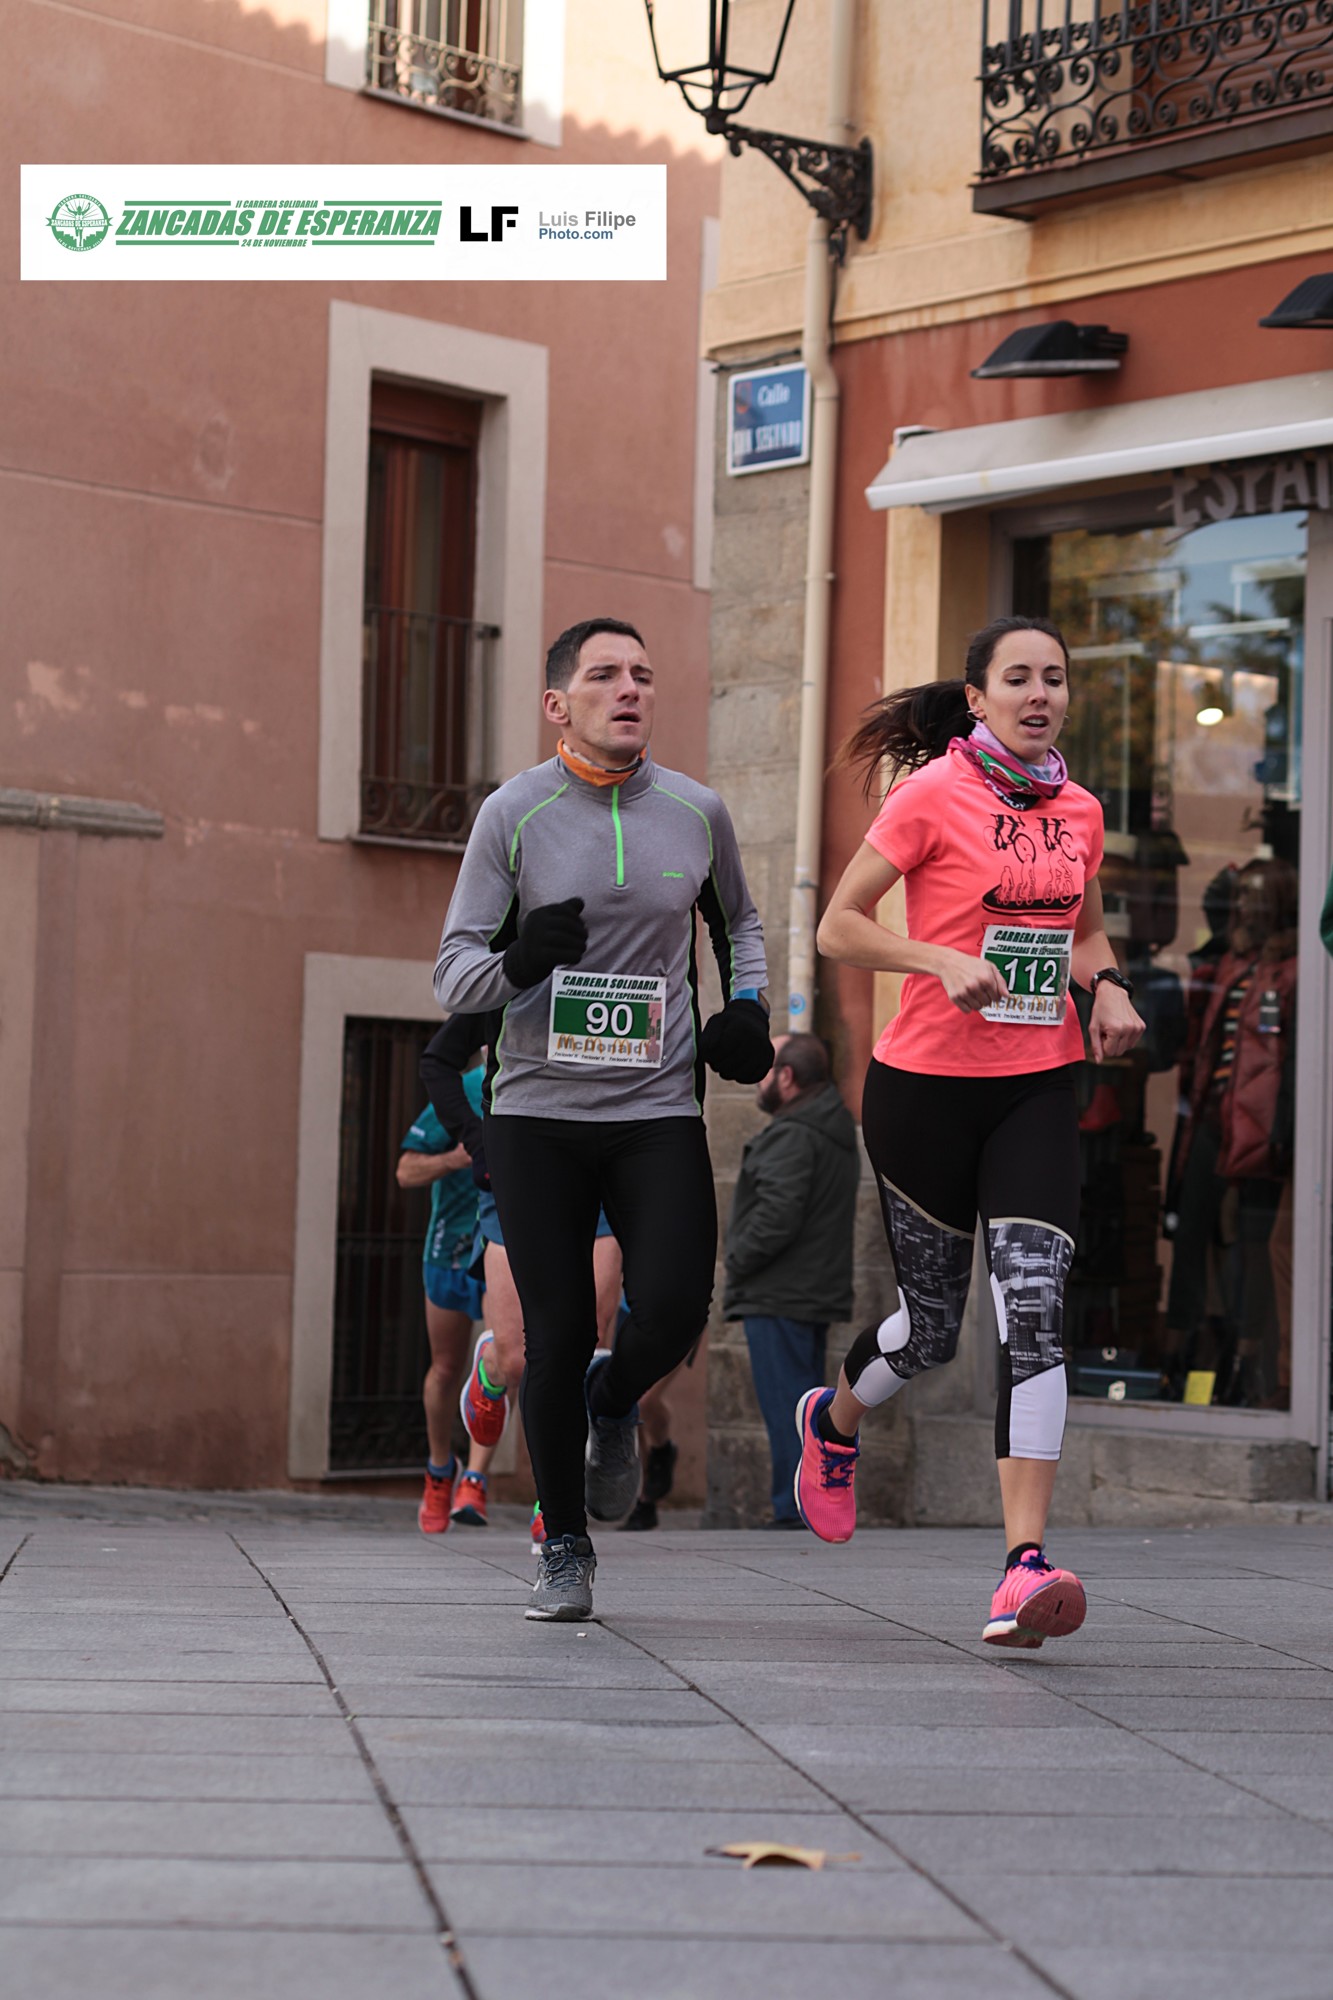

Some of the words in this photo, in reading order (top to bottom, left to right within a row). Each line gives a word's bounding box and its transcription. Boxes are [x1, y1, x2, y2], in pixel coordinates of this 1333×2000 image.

[757, 382, 790, 408] Calle
[994, 930, 1036, 944] CARRERA
[1035, 933, 1069, 945] SOLIDARIA
[1030, 947, 1039, 955] DE
[562, 975, 609, 988] CARRERA
[610, 979, 659, 991] SOLIDARIA
[1004, 958, 1057, 993] 112
[586, 1002, 634, 1037] 90
